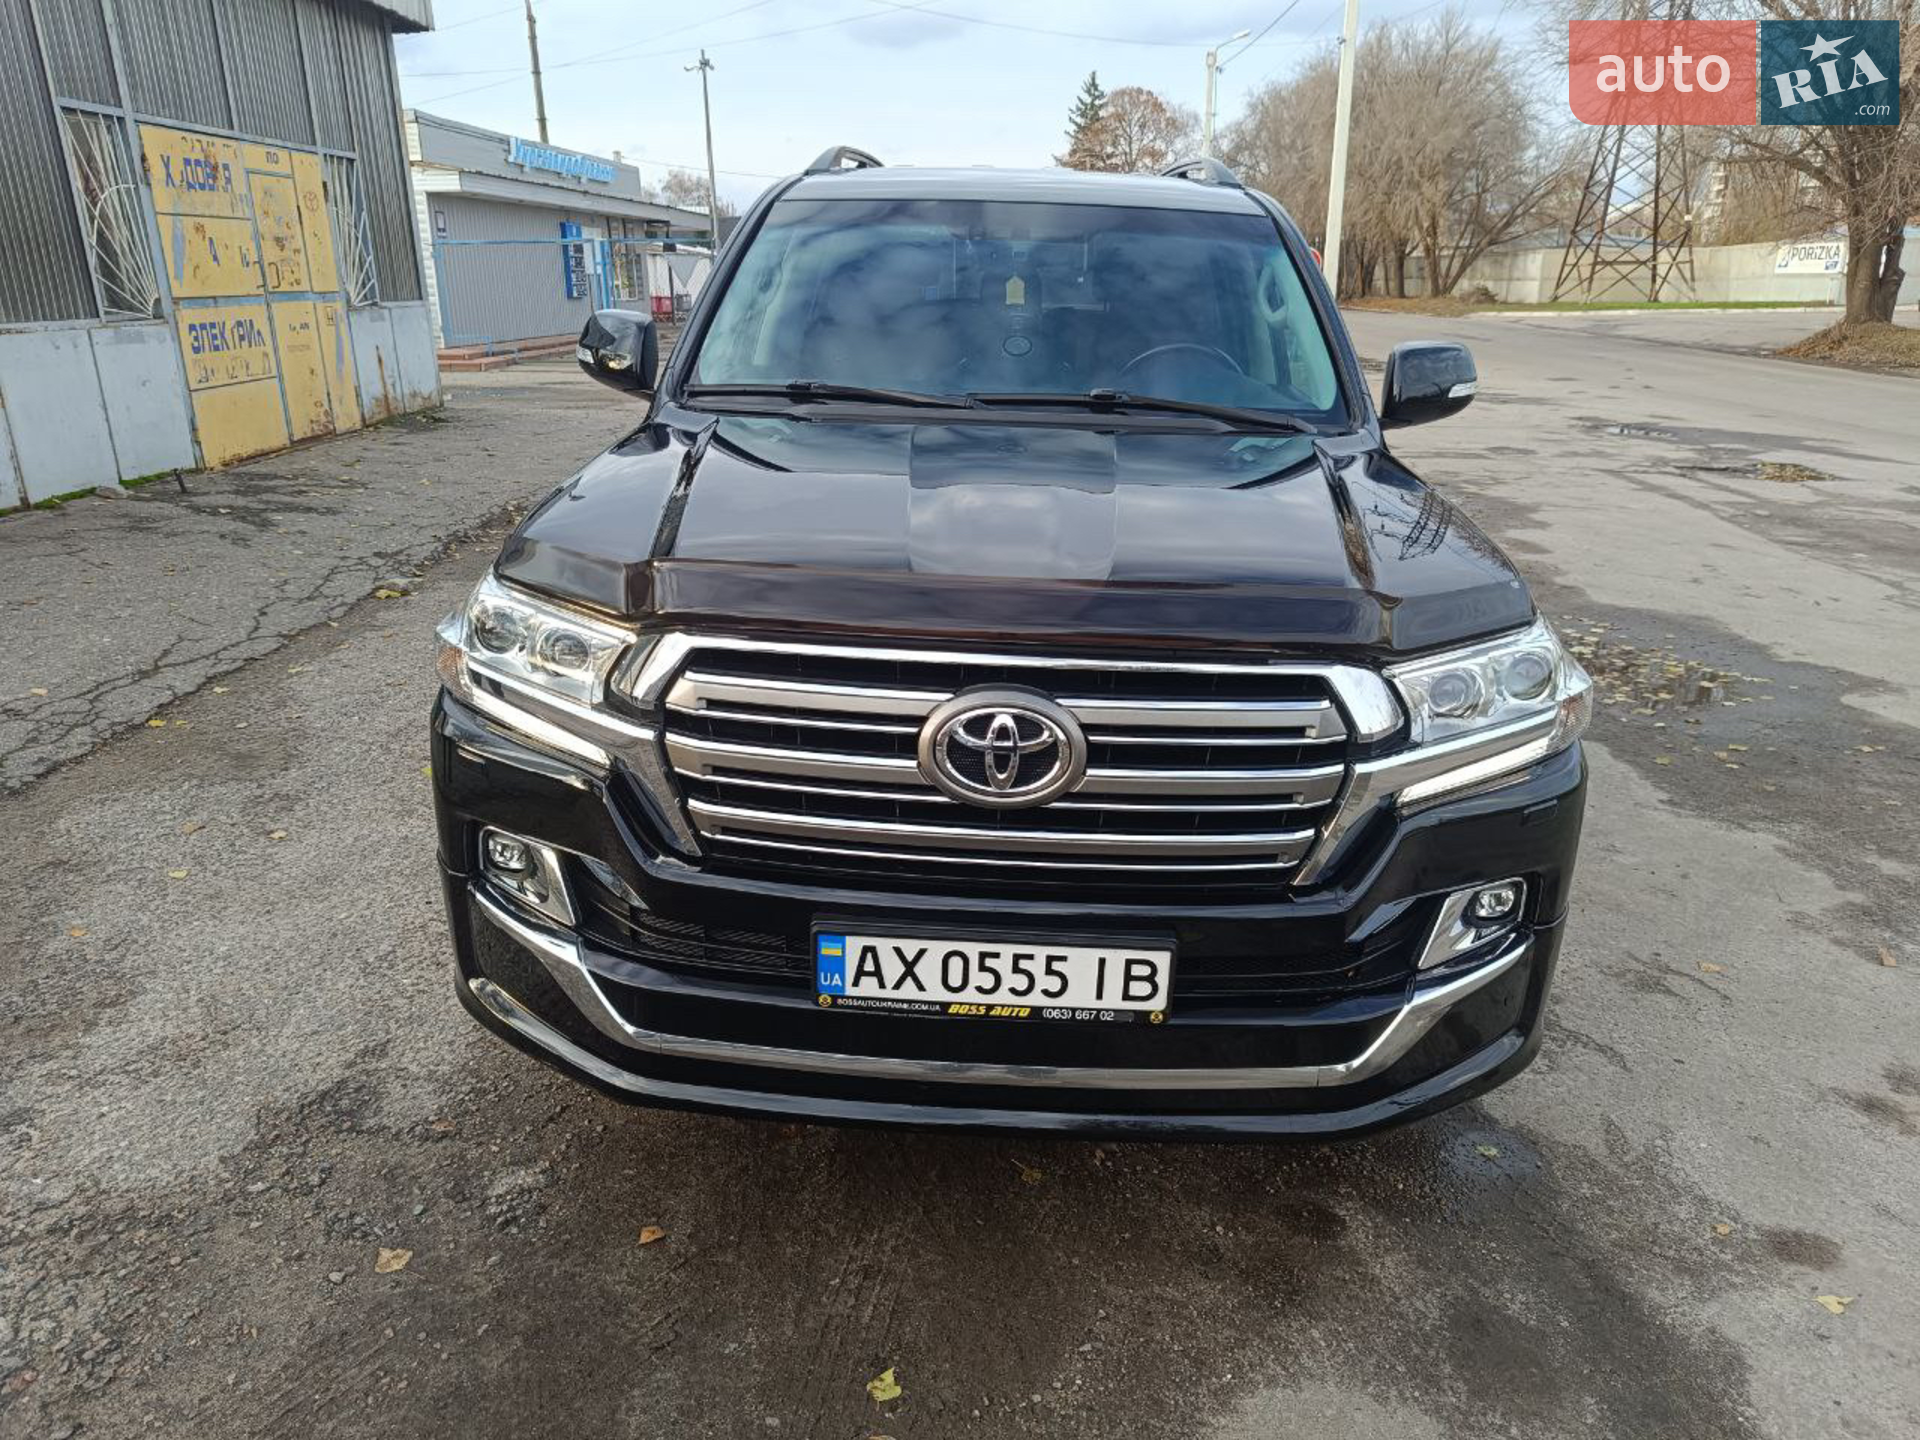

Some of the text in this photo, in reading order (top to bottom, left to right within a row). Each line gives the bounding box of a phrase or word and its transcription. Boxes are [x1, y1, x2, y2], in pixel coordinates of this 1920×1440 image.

[160, 153, 236, 194] ХДОВЯ
[820, 972, 842, 987] UA
[851, 945, 1159, 1002] AX 0555 IB
[948, 1004, 1031, 1017] BOSS AUTO
[1042, 1009, 1072, 1020] (063)
[1075, 1010, 1096, 1020] 667
[1100, 1011, 1114, 1021] 02
